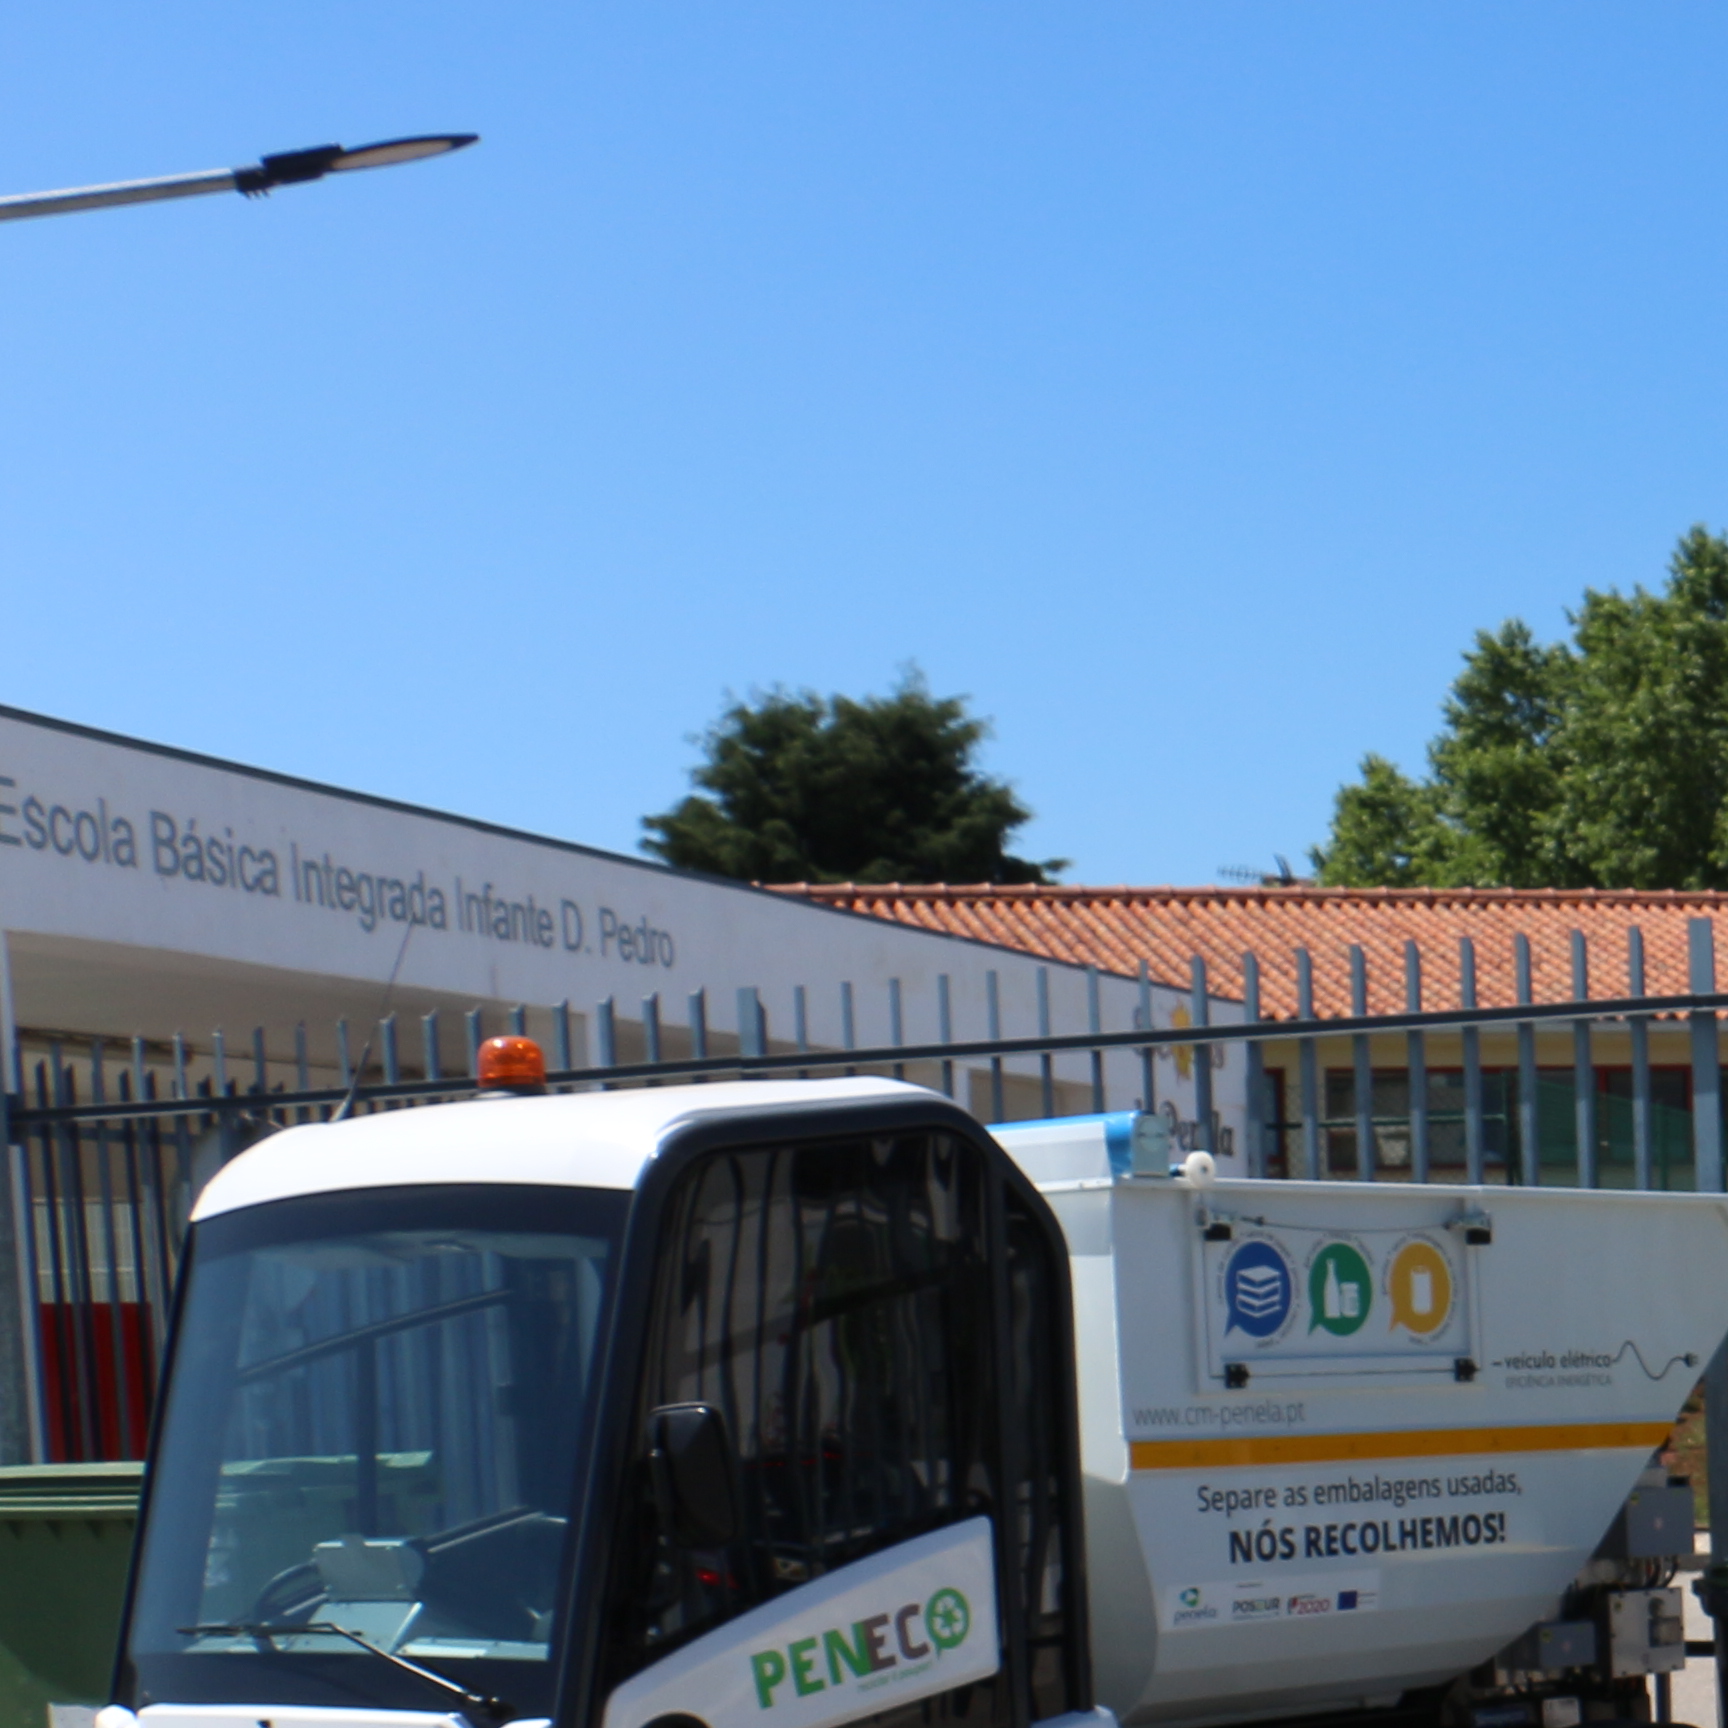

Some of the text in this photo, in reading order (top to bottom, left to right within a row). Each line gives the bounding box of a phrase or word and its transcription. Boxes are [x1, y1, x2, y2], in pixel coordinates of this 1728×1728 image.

[0, 775, 675, 968] Escola Básica Integrada Infante D. Pedro
[1132, 1401, 1306, 1431] www.cm-penela.pt
[1197, 1468, 1522, 1517] Separe as embalagens usadas,
[1229, 1511, 1506, 1564] NÓS RECOLHEMOS!
[751, 1587, 970, 1710] PENECO
